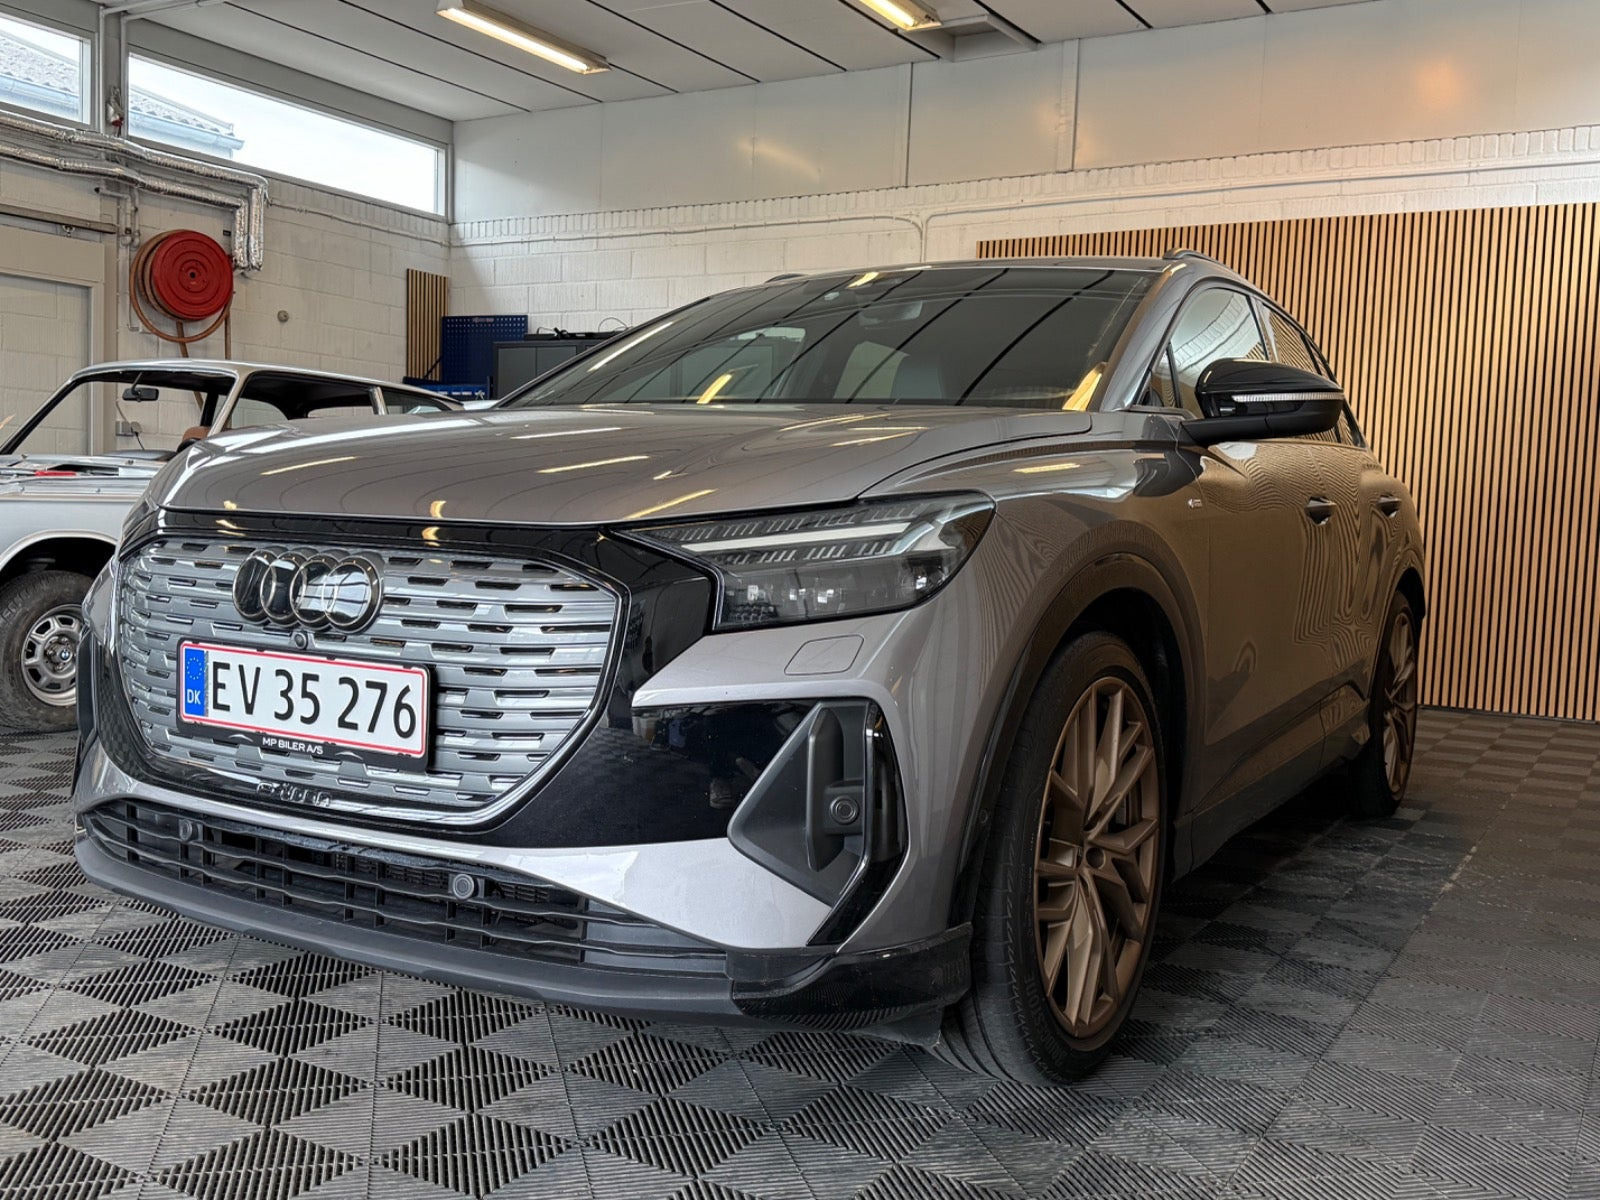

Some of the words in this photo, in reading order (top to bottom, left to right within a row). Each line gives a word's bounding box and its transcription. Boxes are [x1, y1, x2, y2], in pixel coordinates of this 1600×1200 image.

[186, 689, 201, 705] DK
[212, 661, 261, 715] EV
[273, 669, 320, 725] 35
[337, 676, 417, 739] 276
[262, 736, 277, 747] MP
[278, 739, 306, 752] BILER
[306, 743, 324, 755] A/S
